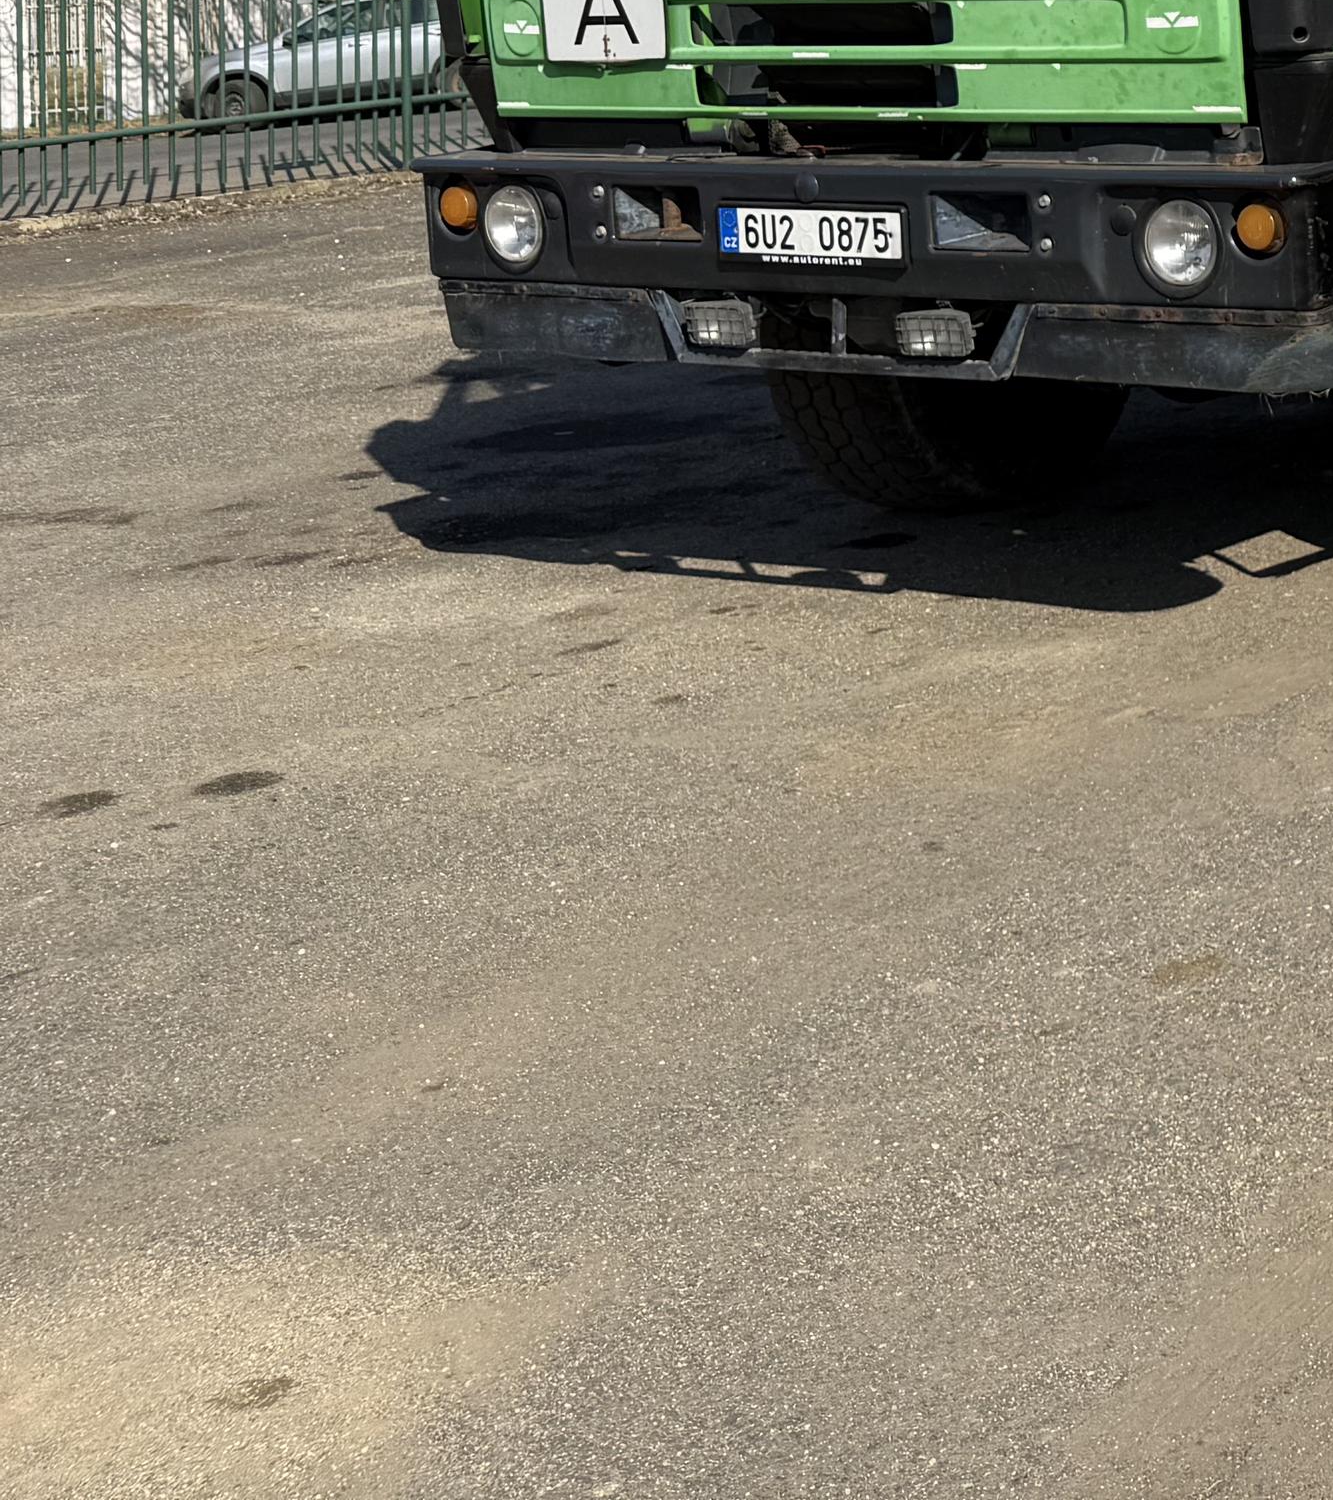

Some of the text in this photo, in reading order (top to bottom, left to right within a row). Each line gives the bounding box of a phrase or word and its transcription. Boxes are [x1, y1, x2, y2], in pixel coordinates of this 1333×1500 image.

[744, 213, 891, 253] 6U2 0875
[723, 236, 738, 248] CZ
[762, 254, 863, 266] www.autorent.eu
